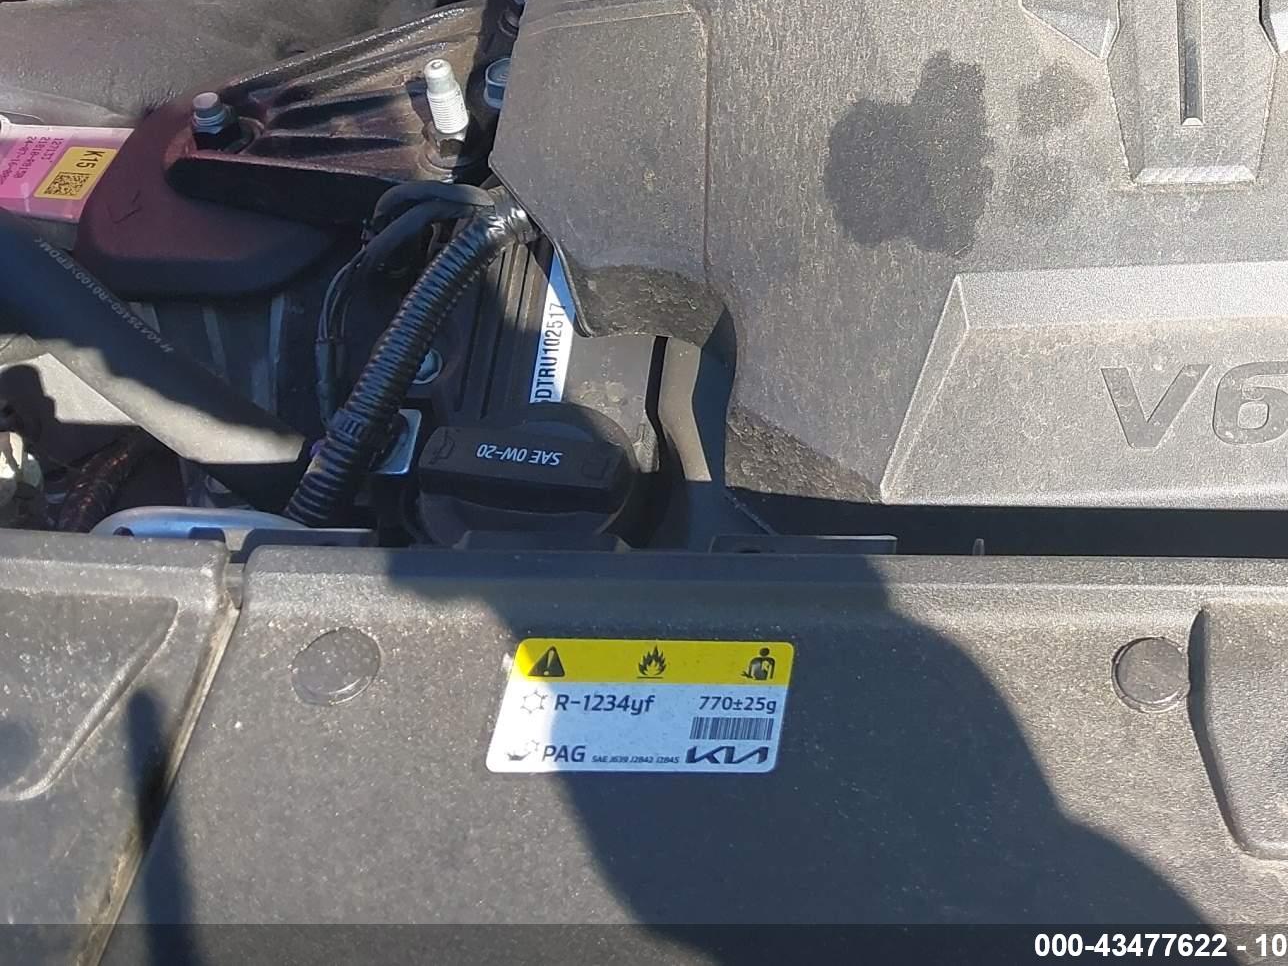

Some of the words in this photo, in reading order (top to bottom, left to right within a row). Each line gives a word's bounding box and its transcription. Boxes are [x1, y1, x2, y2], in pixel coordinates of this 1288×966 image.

[75, 150, 106, 169] K15
[533, 302, 567, 402] DTRU102517
[476, 443, 528, 462] 0W-20
[528, 450, 563, 466] SAE
[554, 694, 656, 716] R-1234yf
[698, 695, 777, 715] 770±25g
[542, 744, 586, 764] PAG
